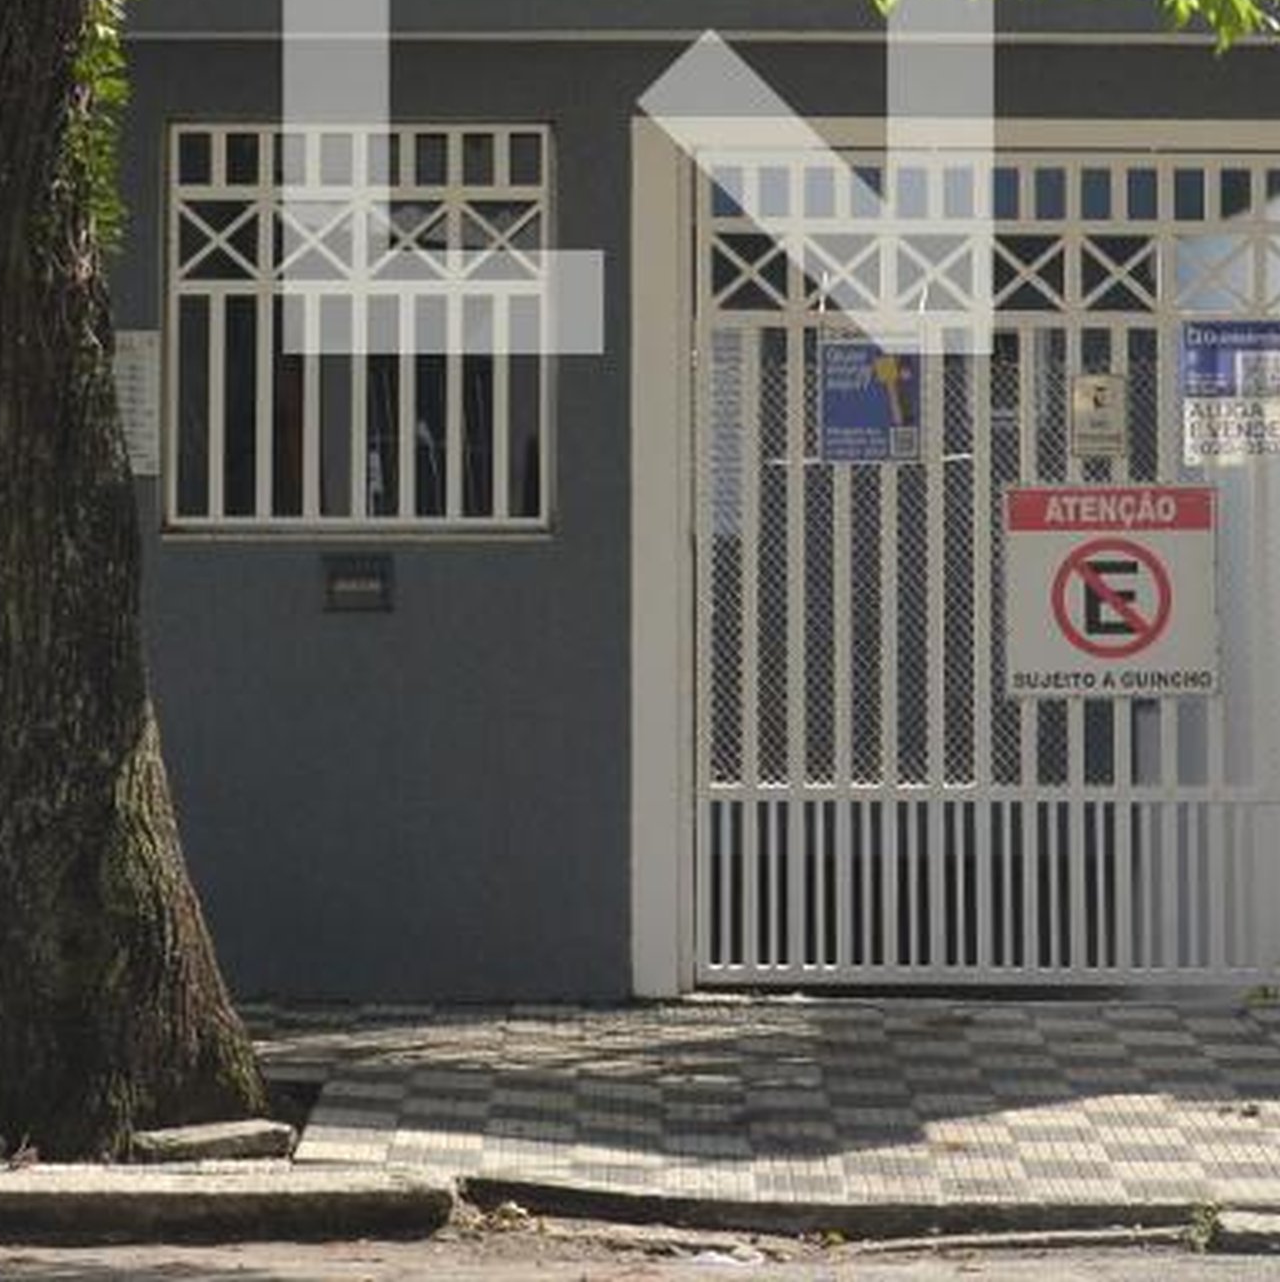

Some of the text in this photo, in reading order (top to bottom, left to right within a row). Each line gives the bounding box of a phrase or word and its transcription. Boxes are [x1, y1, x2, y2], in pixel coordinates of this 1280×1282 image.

[1044, 491, 1178, 526] ATENÇÃO
[1011, 671, 1213, 689] SUJEITO A GUINCHO
